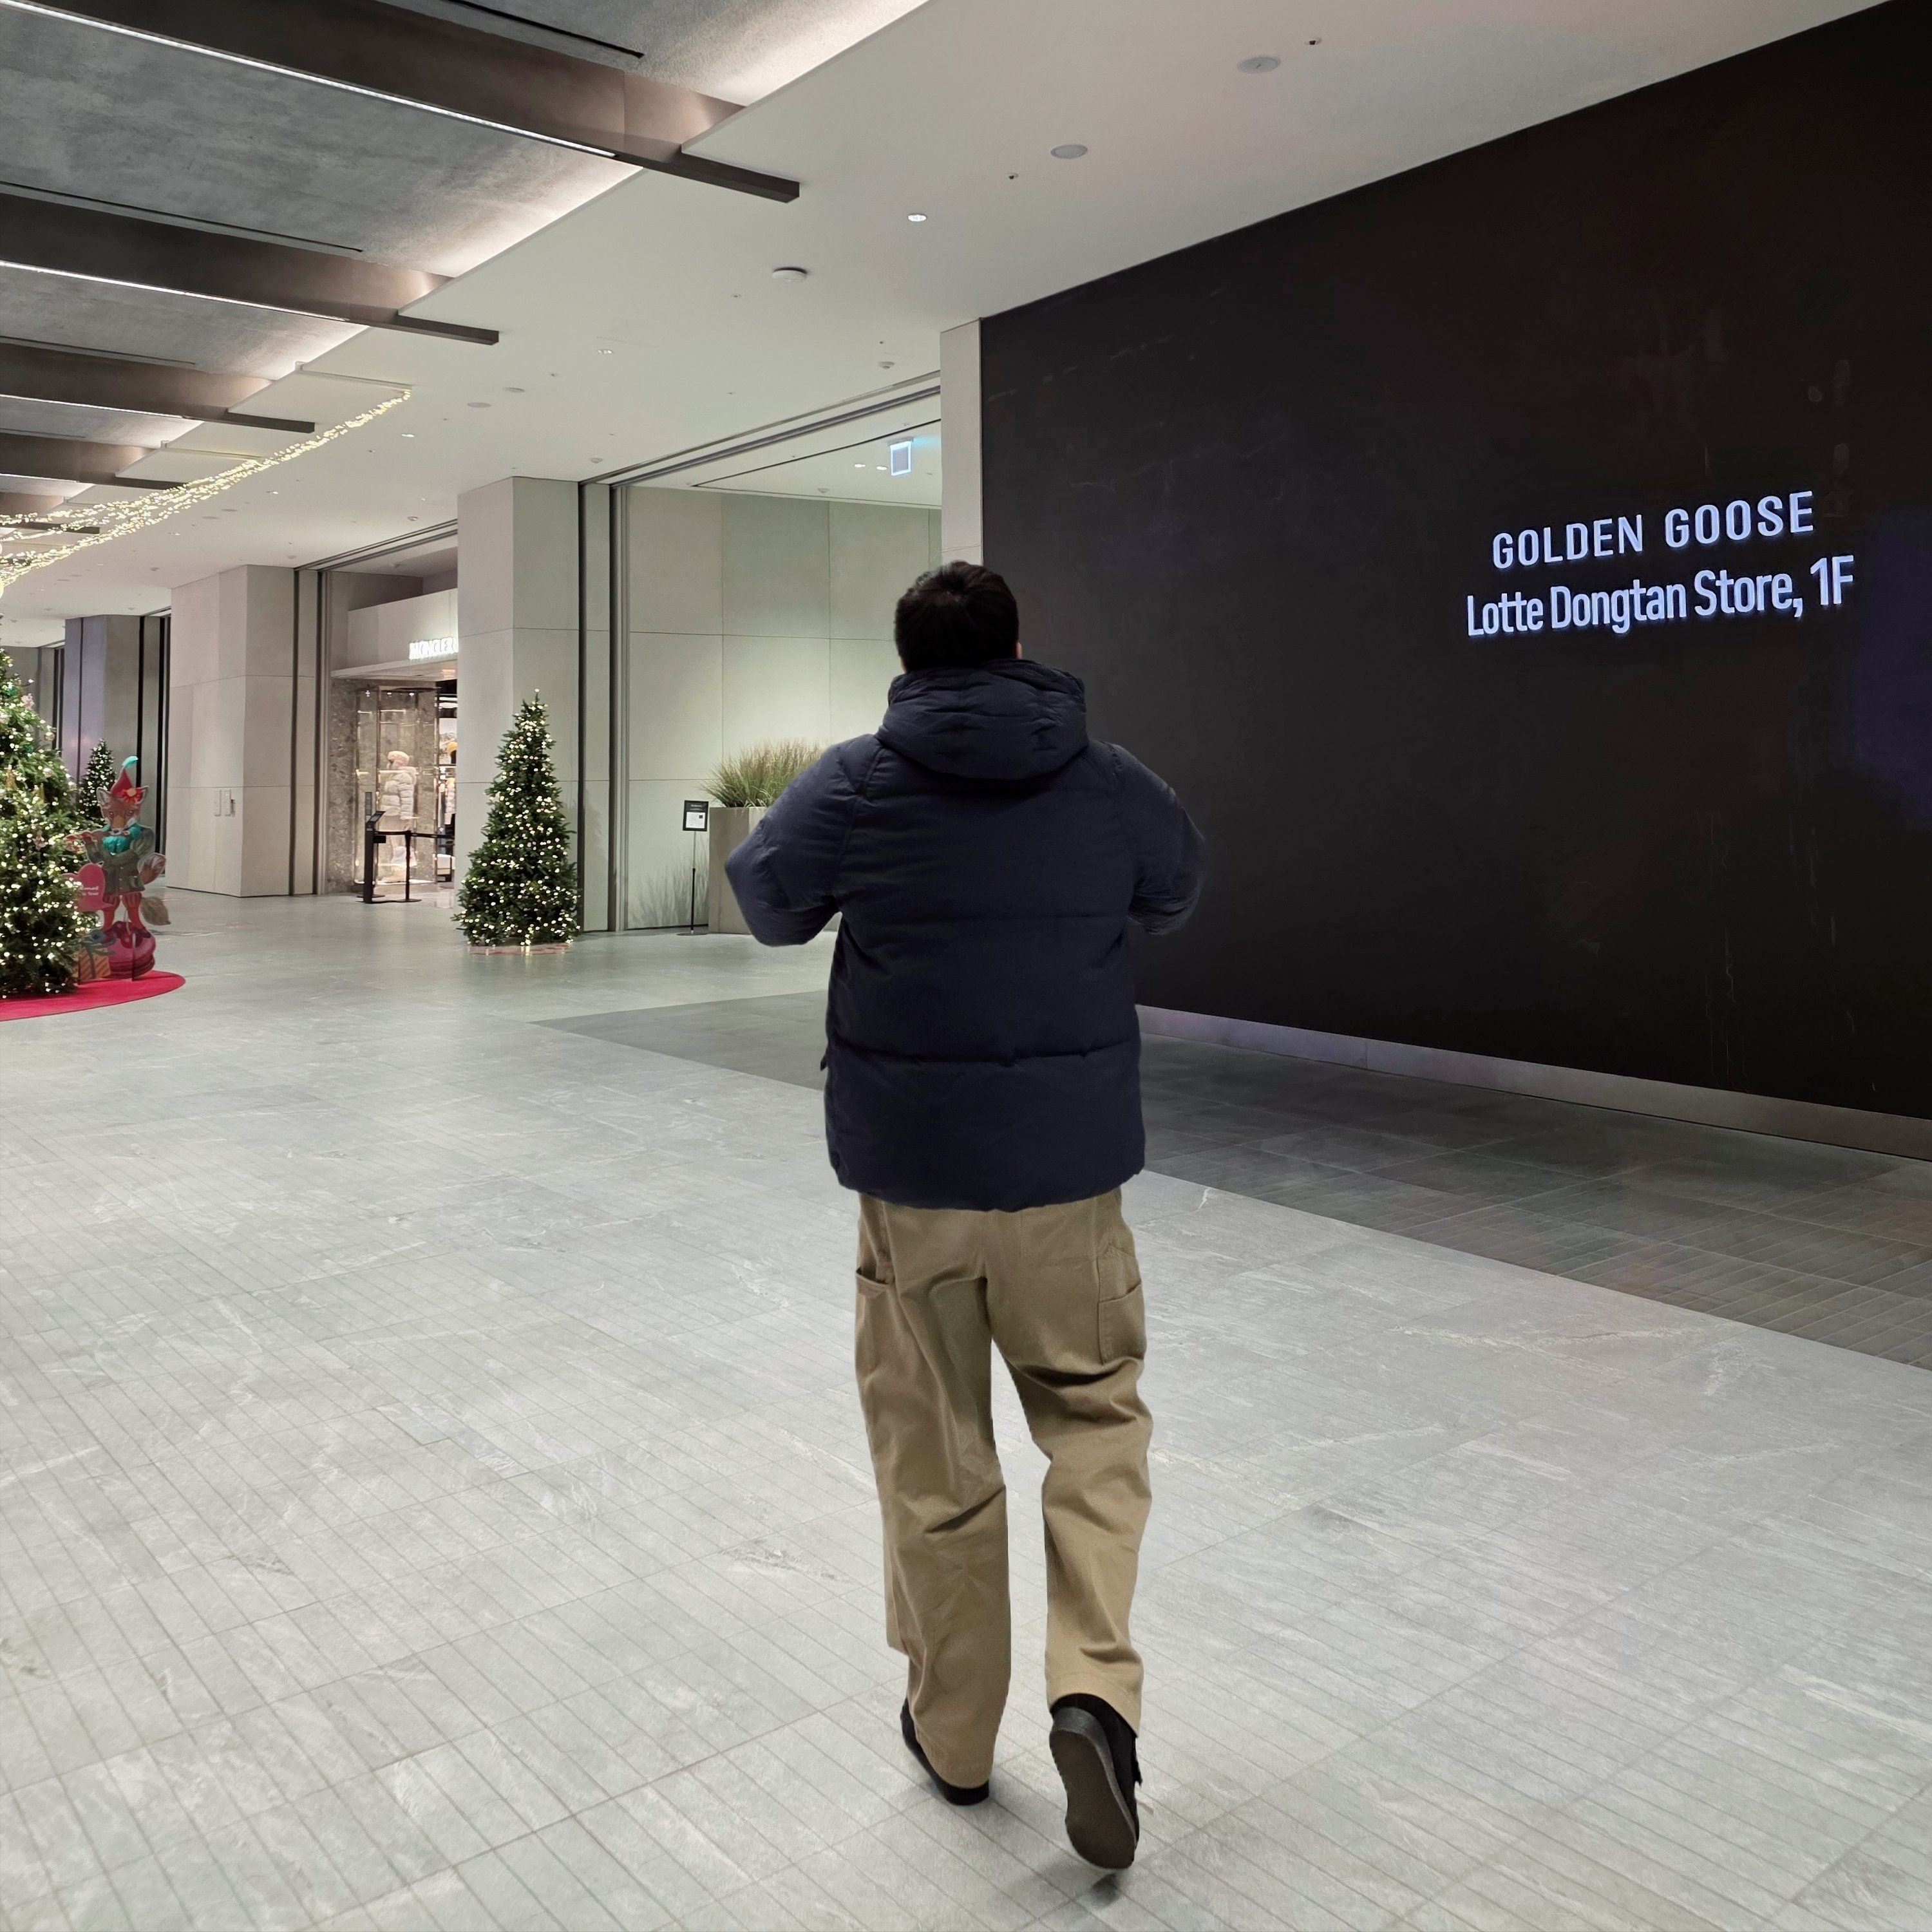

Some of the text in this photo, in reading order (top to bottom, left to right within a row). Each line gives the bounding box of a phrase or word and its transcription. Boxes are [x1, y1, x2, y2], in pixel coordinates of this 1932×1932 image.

[1493, 491, 1814, 569] GOLDEN GOOSE
[1467, 554, 1854, 636] Lotte Dongtan Store, 1F
